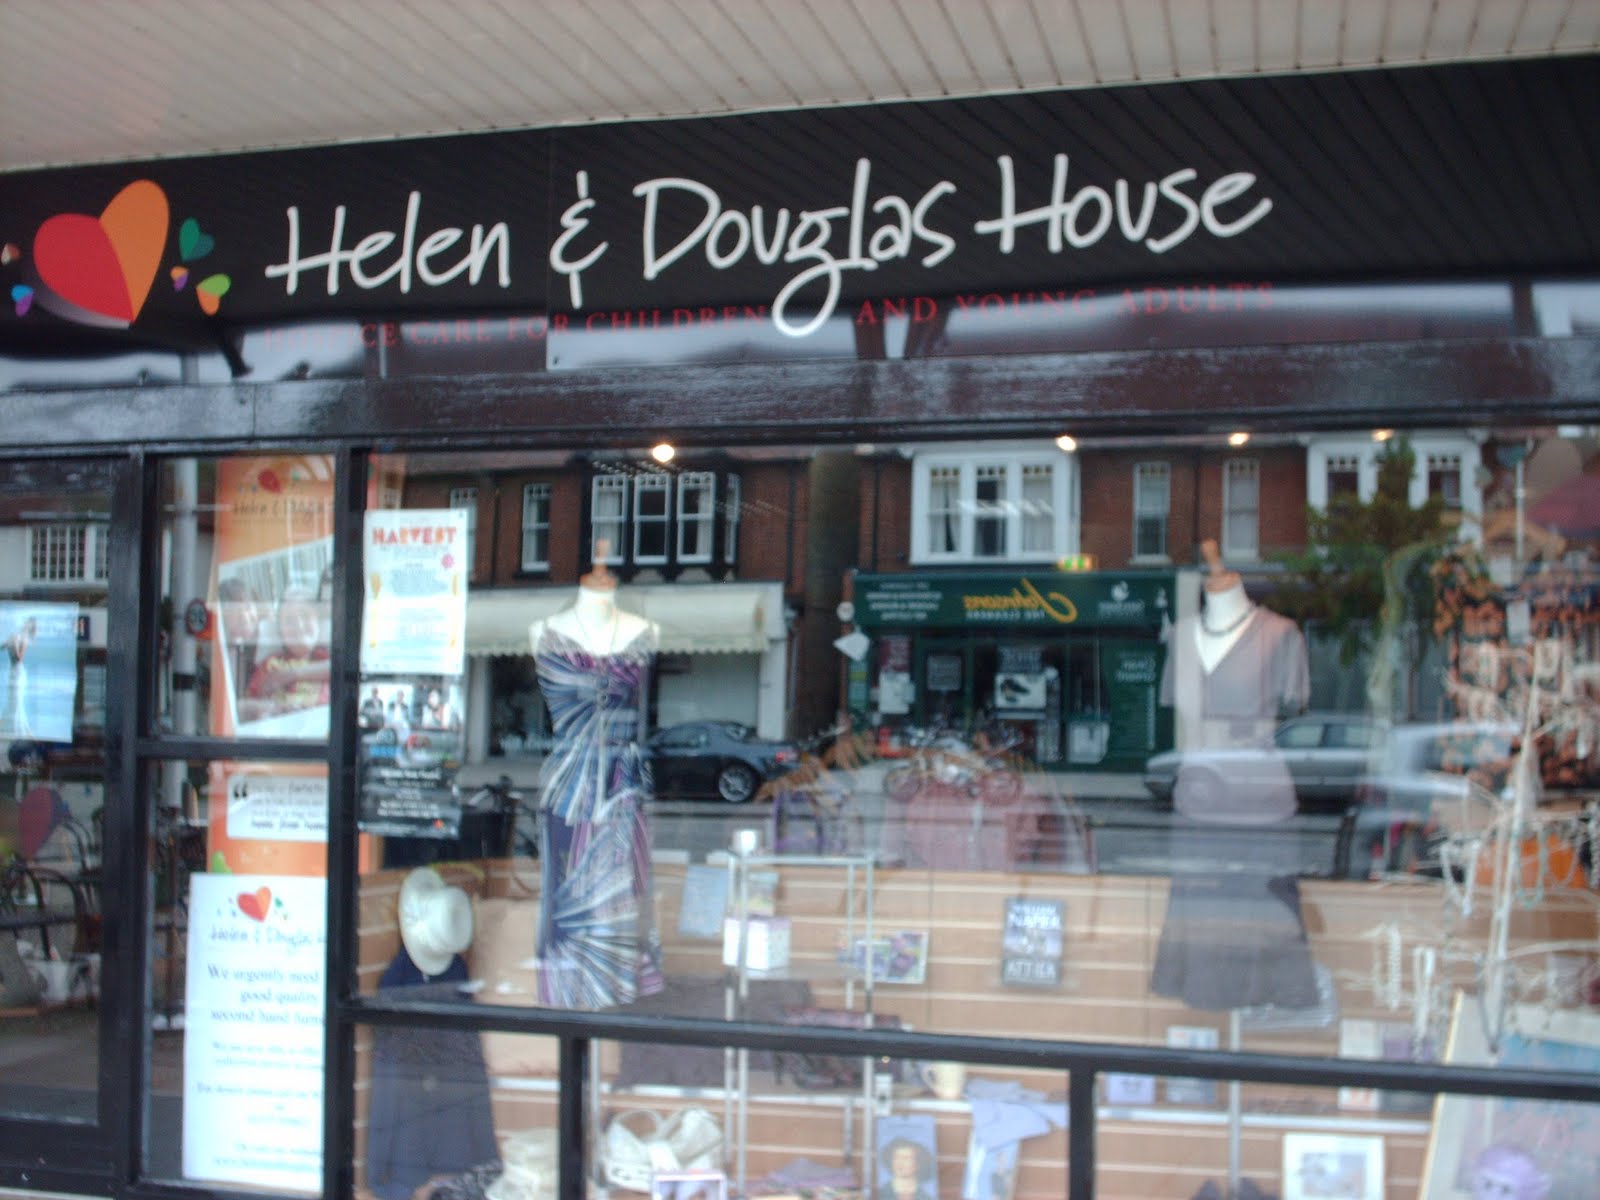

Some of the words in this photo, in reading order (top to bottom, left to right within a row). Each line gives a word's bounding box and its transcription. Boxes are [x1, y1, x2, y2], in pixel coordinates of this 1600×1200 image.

[265, 190, 511, 295] Helen
[549, 170, 608, 309] &
[632, 158, 958, 337] Douglas
[974, 153, 1274, 254] House
[411, 316, 492, 345] CARE
[506, 313, 571, 341] FOR
[585, 305, 768, 334] CHILDREN
[856, 297, 938, 325] AND
[955, 289, 1097, 320] YOUNG
[1117, 282, 1275, 316] ADULTS
[372, 526, 457, 545] HARVEST
